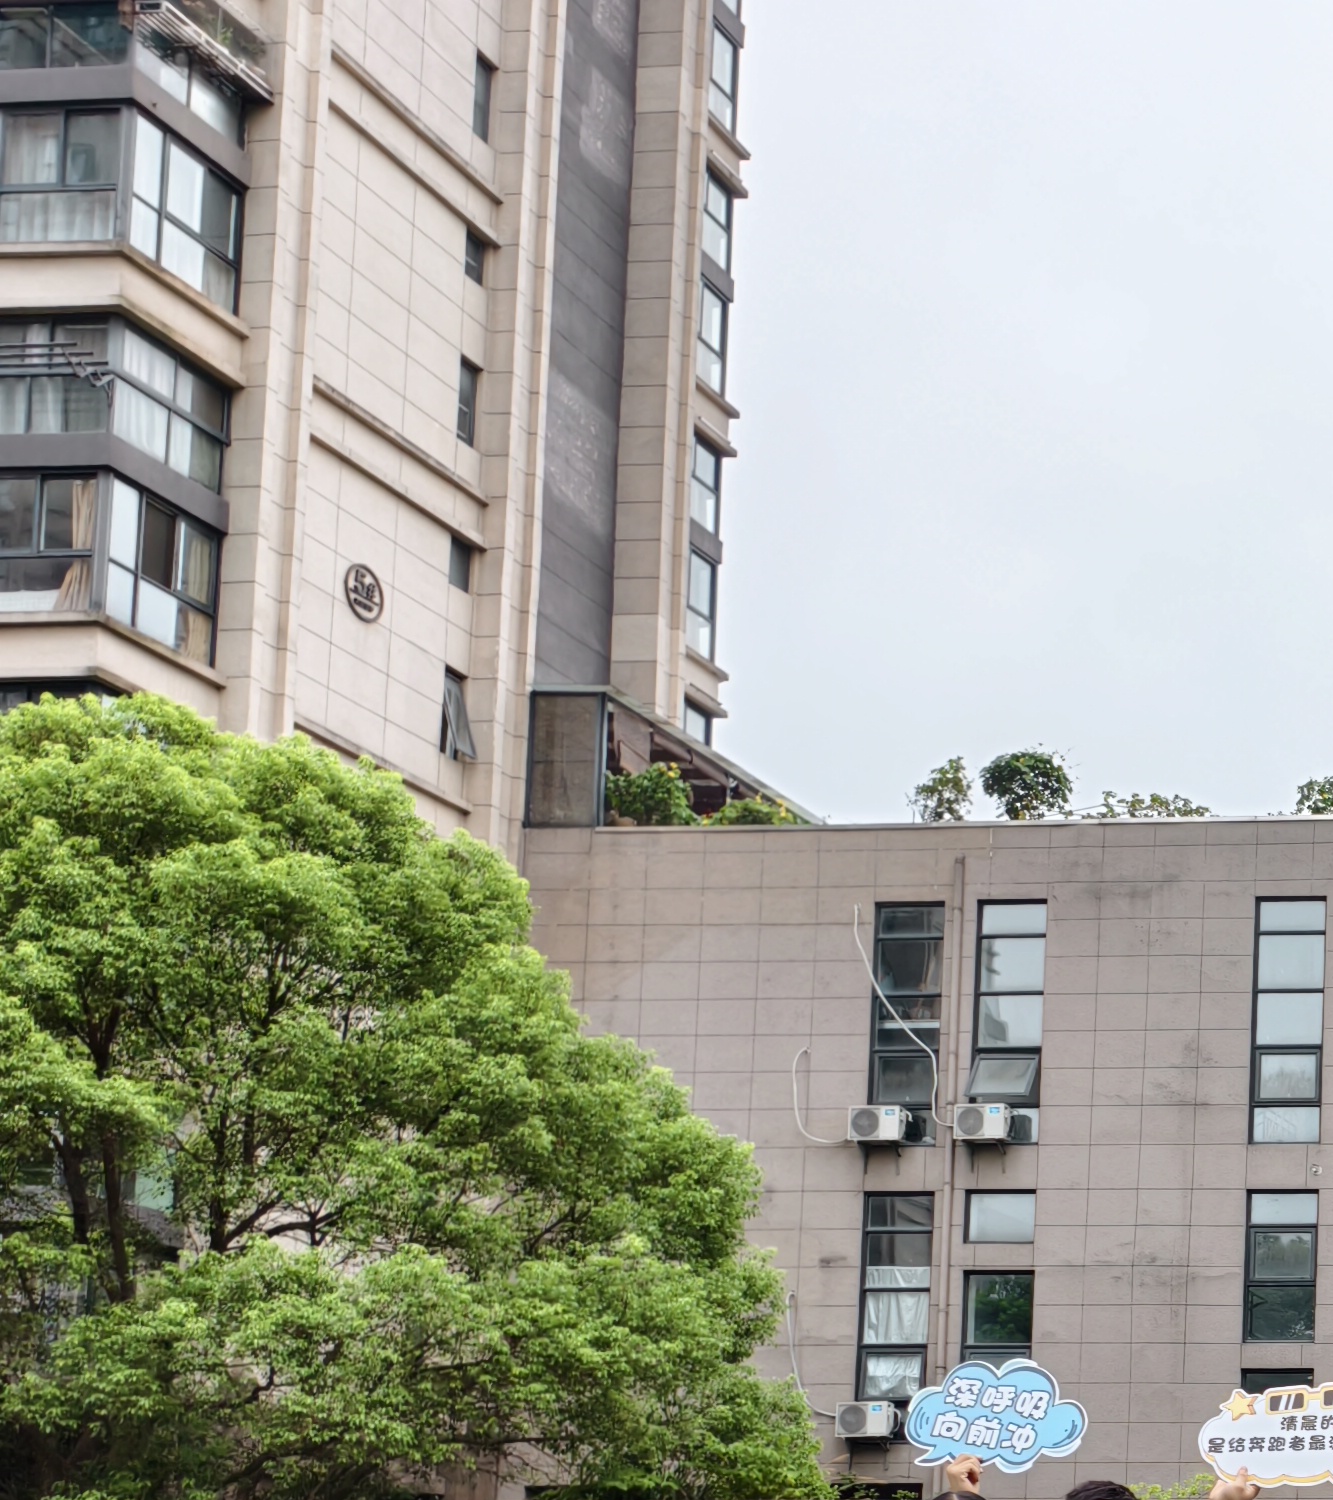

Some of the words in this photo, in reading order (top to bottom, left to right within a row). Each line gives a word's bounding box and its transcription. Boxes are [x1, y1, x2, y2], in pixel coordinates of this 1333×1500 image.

[944, 1376, 1051, 1421] 深呼吸
[930, 1410, 1038, 1455] 向前冲
